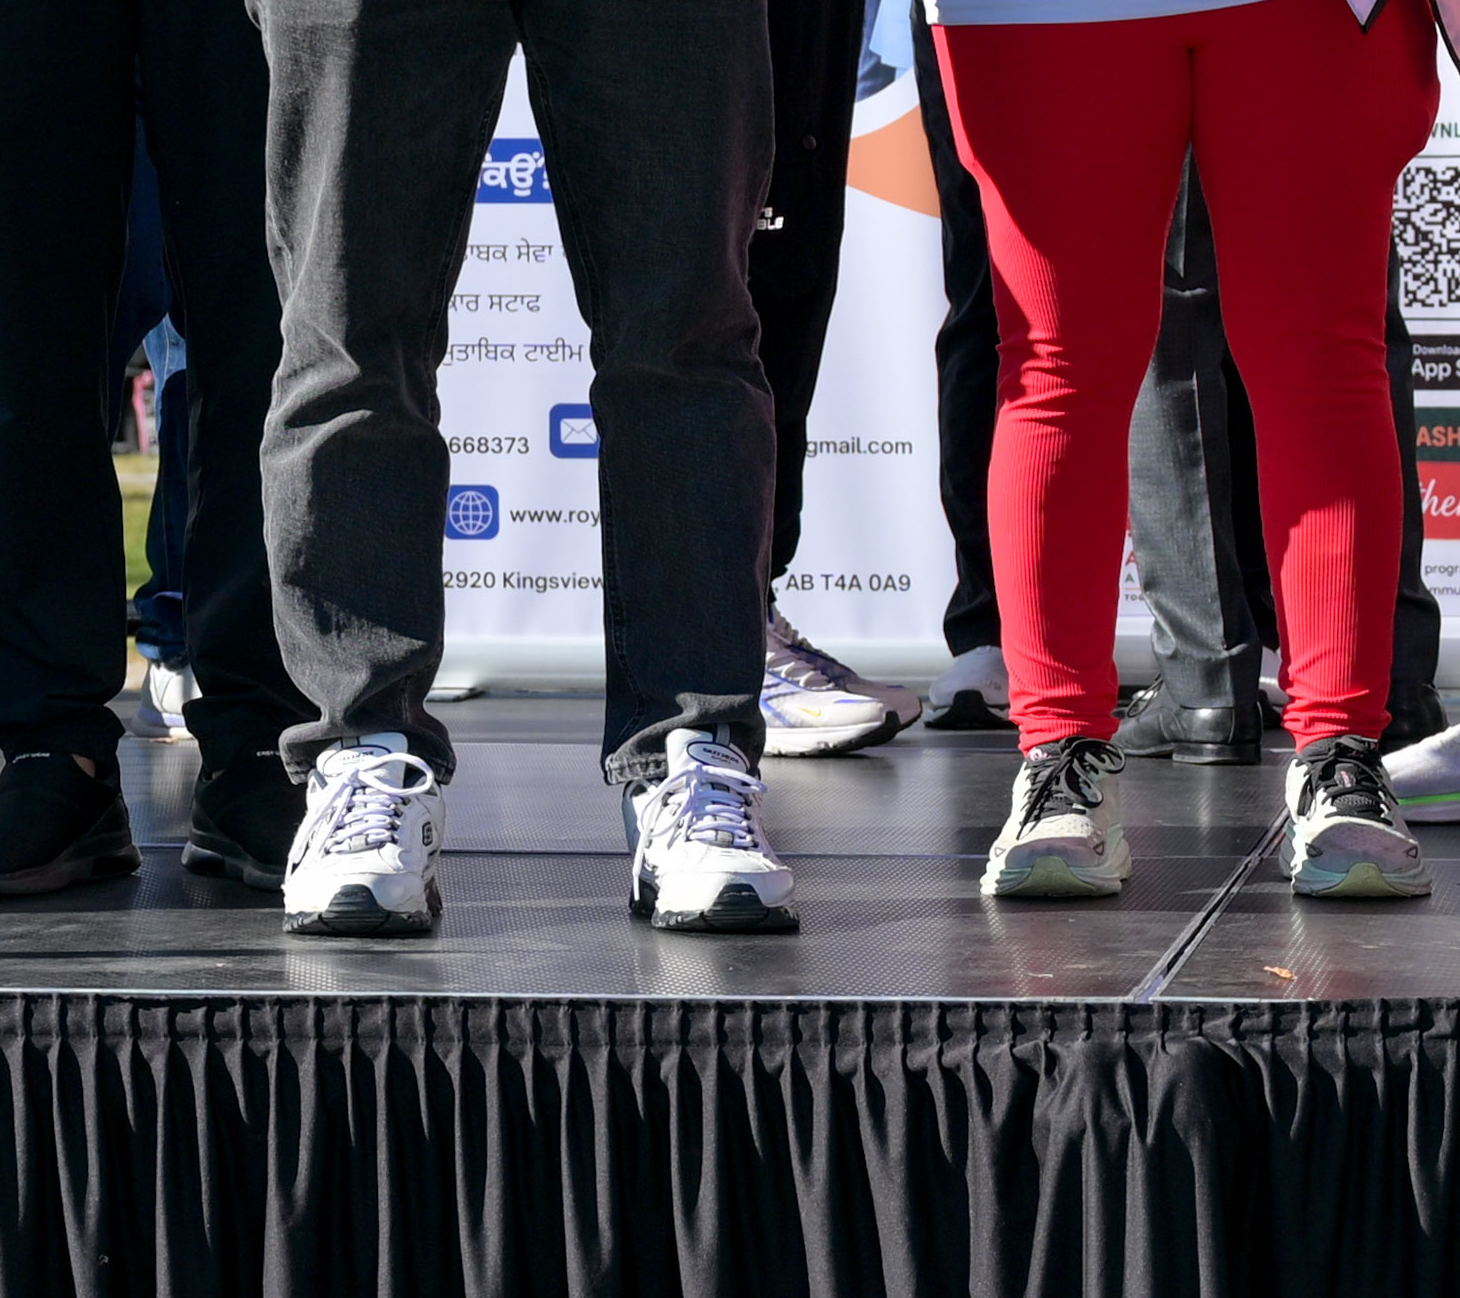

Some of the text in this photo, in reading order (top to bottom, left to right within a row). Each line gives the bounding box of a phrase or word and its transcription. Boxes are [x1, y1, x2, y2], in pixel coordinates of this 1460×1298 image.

[1412, 358, 1452, 384] App
[442, 571, 496, 590] 2920
[502, 570, 606, 594] Kingsview
[785, 573, 815, 592] AB
[820, 573, 862, 592] T4A
